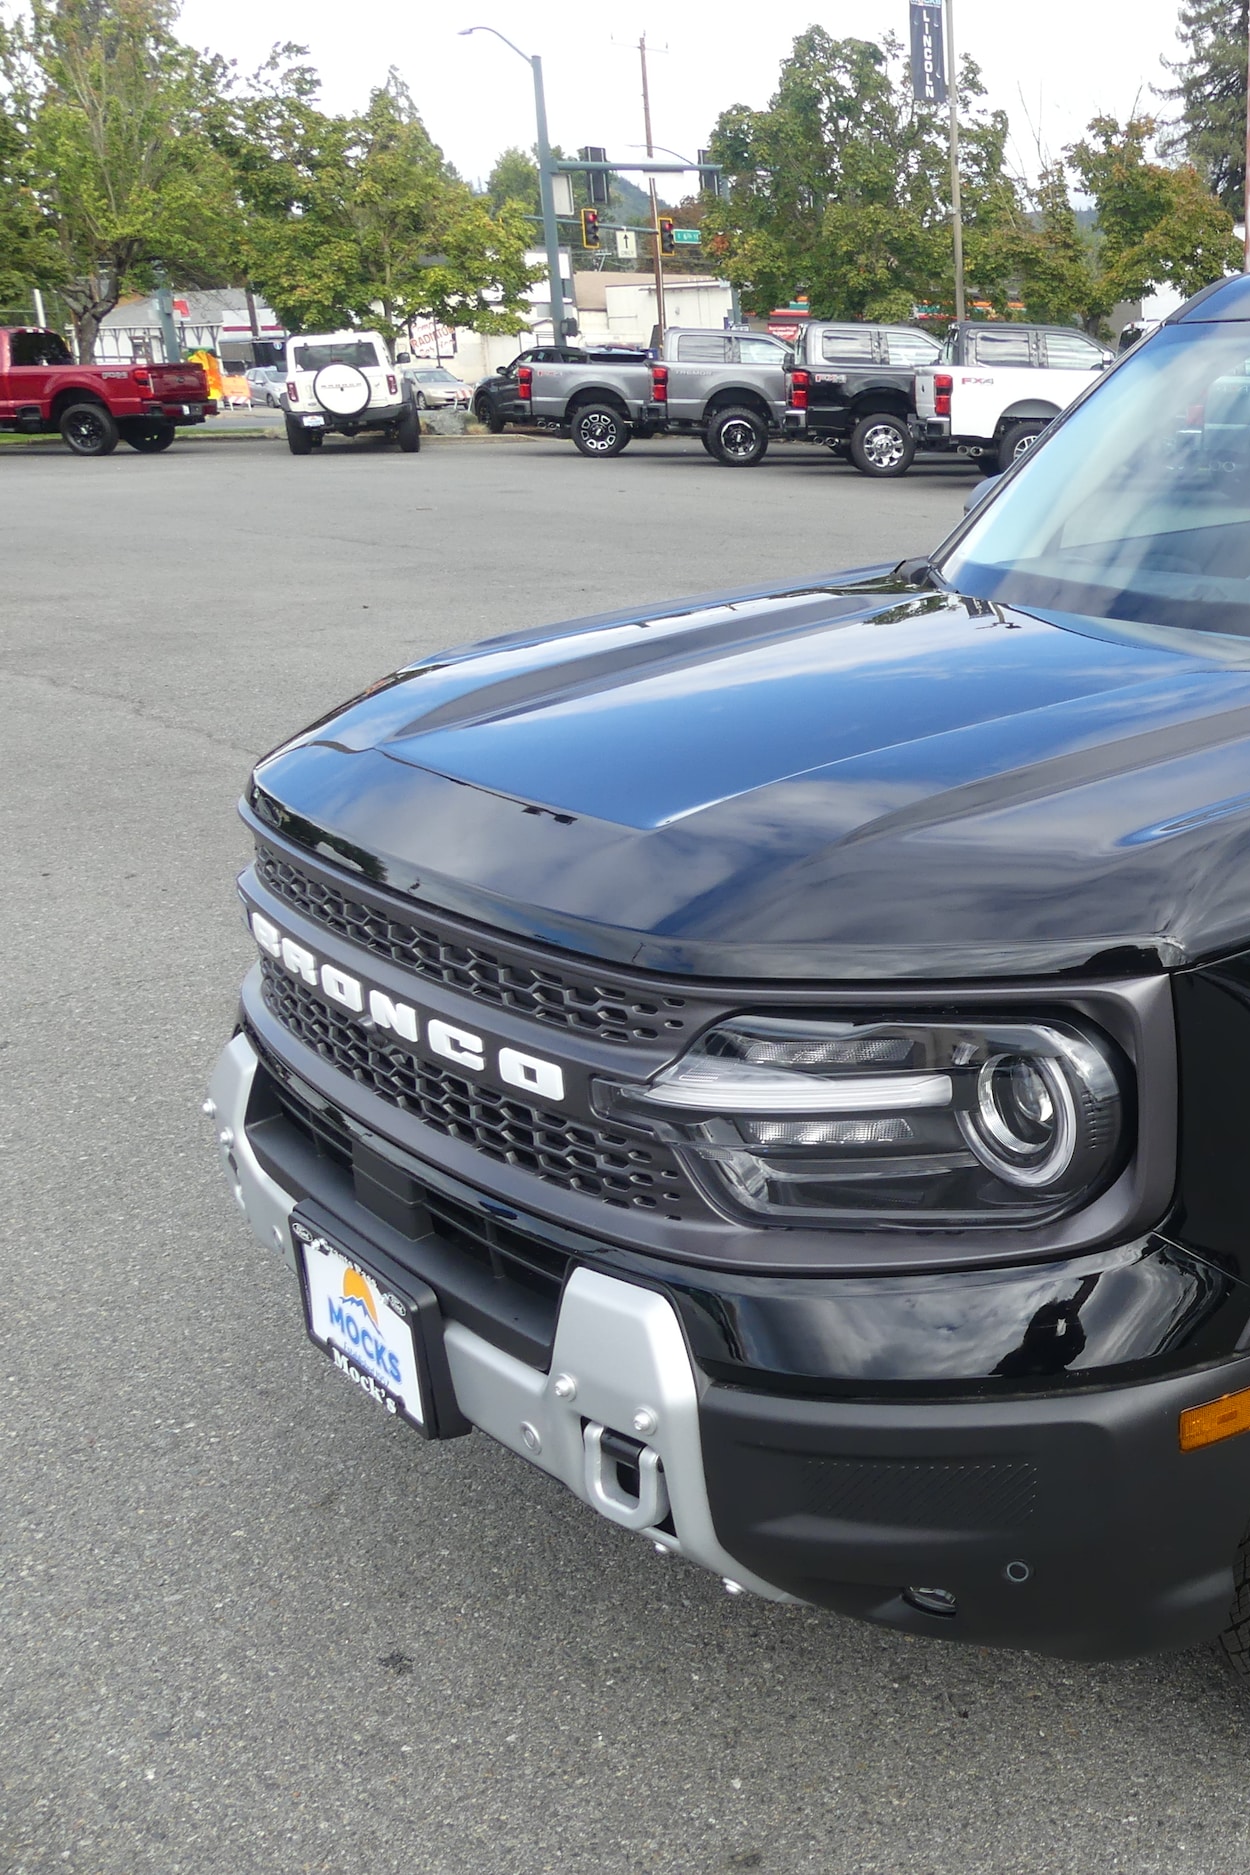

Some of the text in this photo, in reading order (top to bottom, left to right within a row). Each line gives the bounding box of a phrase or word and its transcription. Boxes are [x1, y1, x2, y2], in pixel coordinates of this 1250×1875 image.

[922, 9, 935, 98] LINCOLN
[961, 377, 995, 385] FX4
[251, 912, 565, 1101] BRONCO
[328, 1296, 402, 1385] MOCKS
[332, 1347, 398, 1415] Mock's
